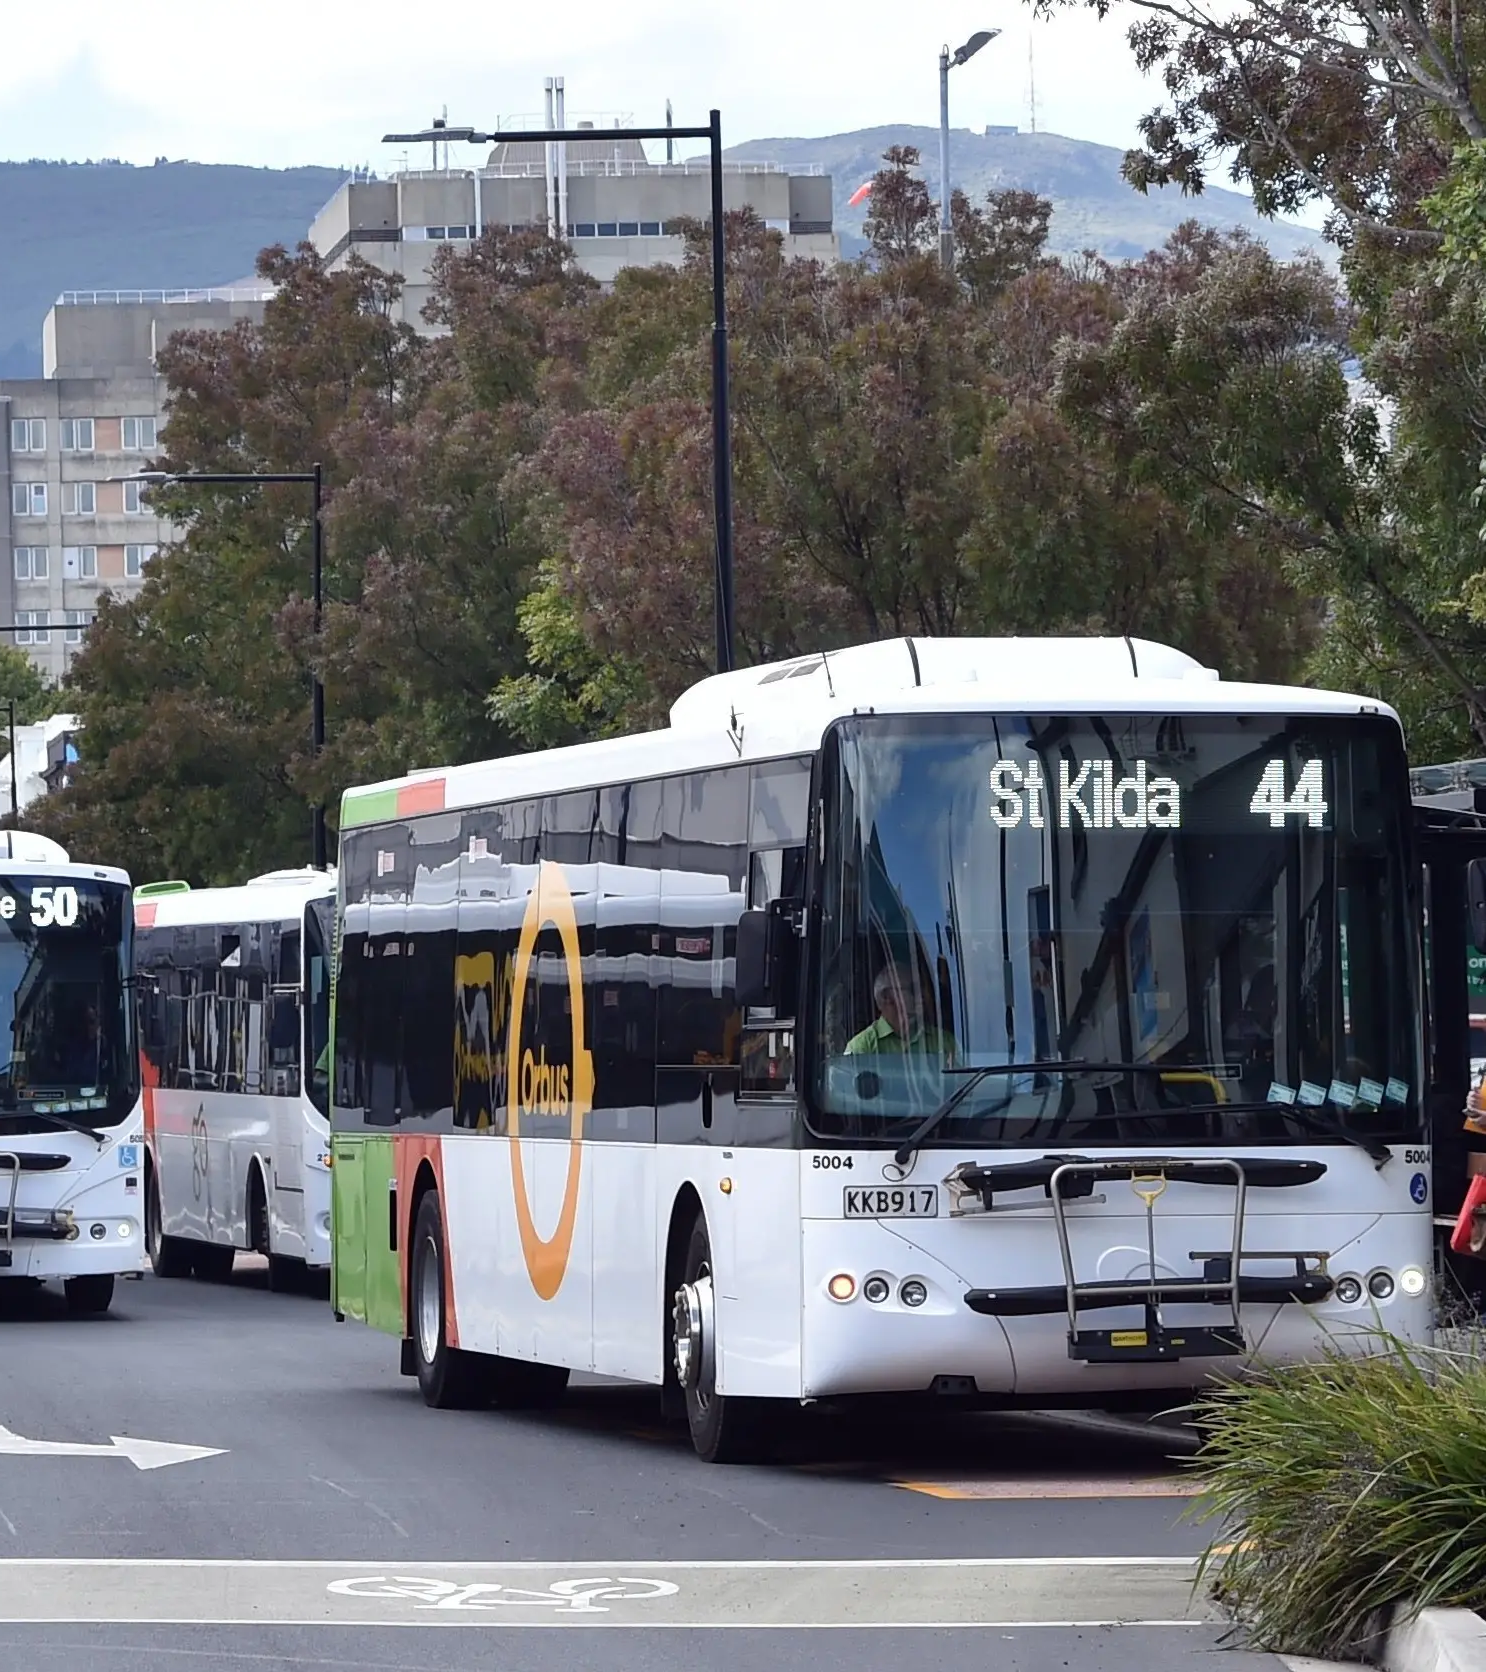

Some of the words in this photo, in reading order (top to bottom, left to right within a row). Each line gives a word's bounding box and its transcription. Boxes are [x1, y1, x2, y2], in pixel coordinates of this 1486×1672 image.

[990, 759, 1045, 828] St
[1059, 759, 1181, 828] Kilda
[1249, 759, 1329, 828] 44
[29, 886, 79, 927] 50
[521, 1043, 569, 1116] Orbus
[812, 1154, 854, 1170] 5004
[847, 1190, 934, 1213] KKB917
